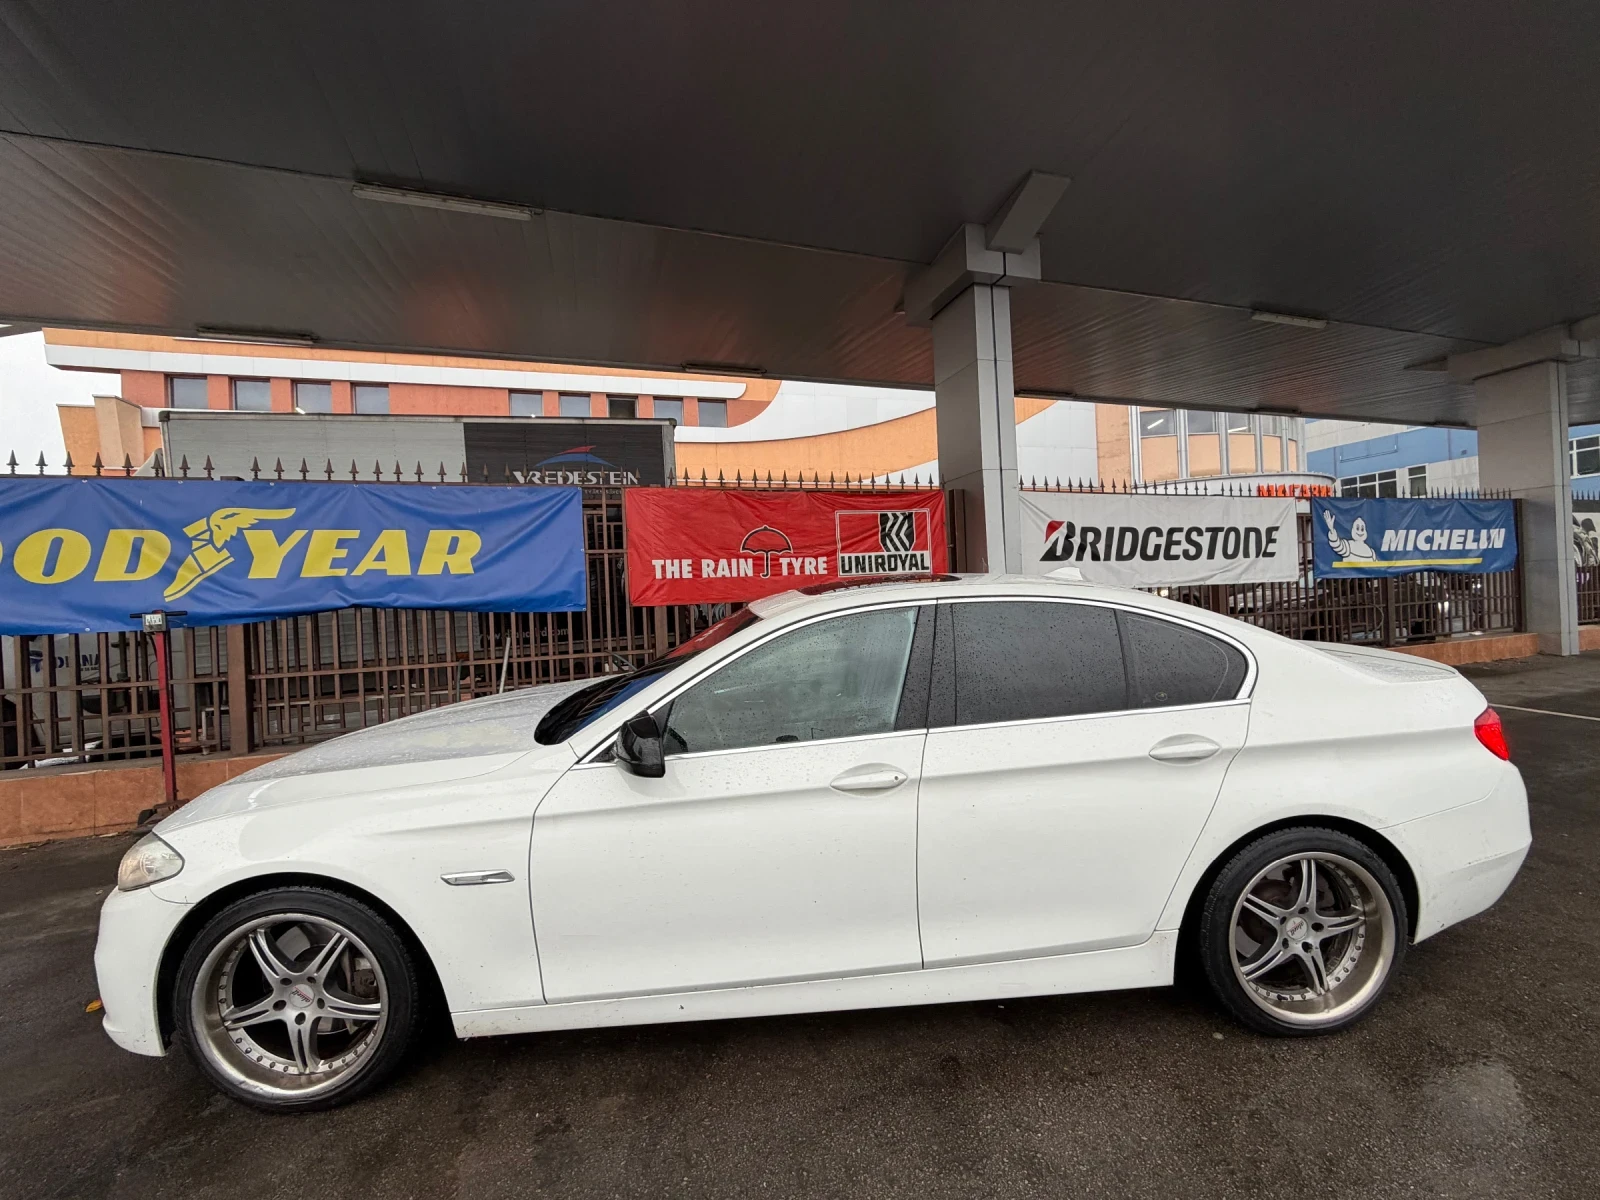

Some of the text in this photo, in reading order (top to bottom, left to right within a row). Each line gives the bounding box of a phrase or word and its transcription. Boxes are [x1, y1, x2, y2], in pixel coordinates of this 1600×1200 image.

[1039, 520, 1280, 561] BRIDGESTONE
[1381, 528, 1506, 551] MICHELIN
[652, 557, 828, 579] THE RAIN TYRE
[841, 553, 930, 574] UNIROYAL
